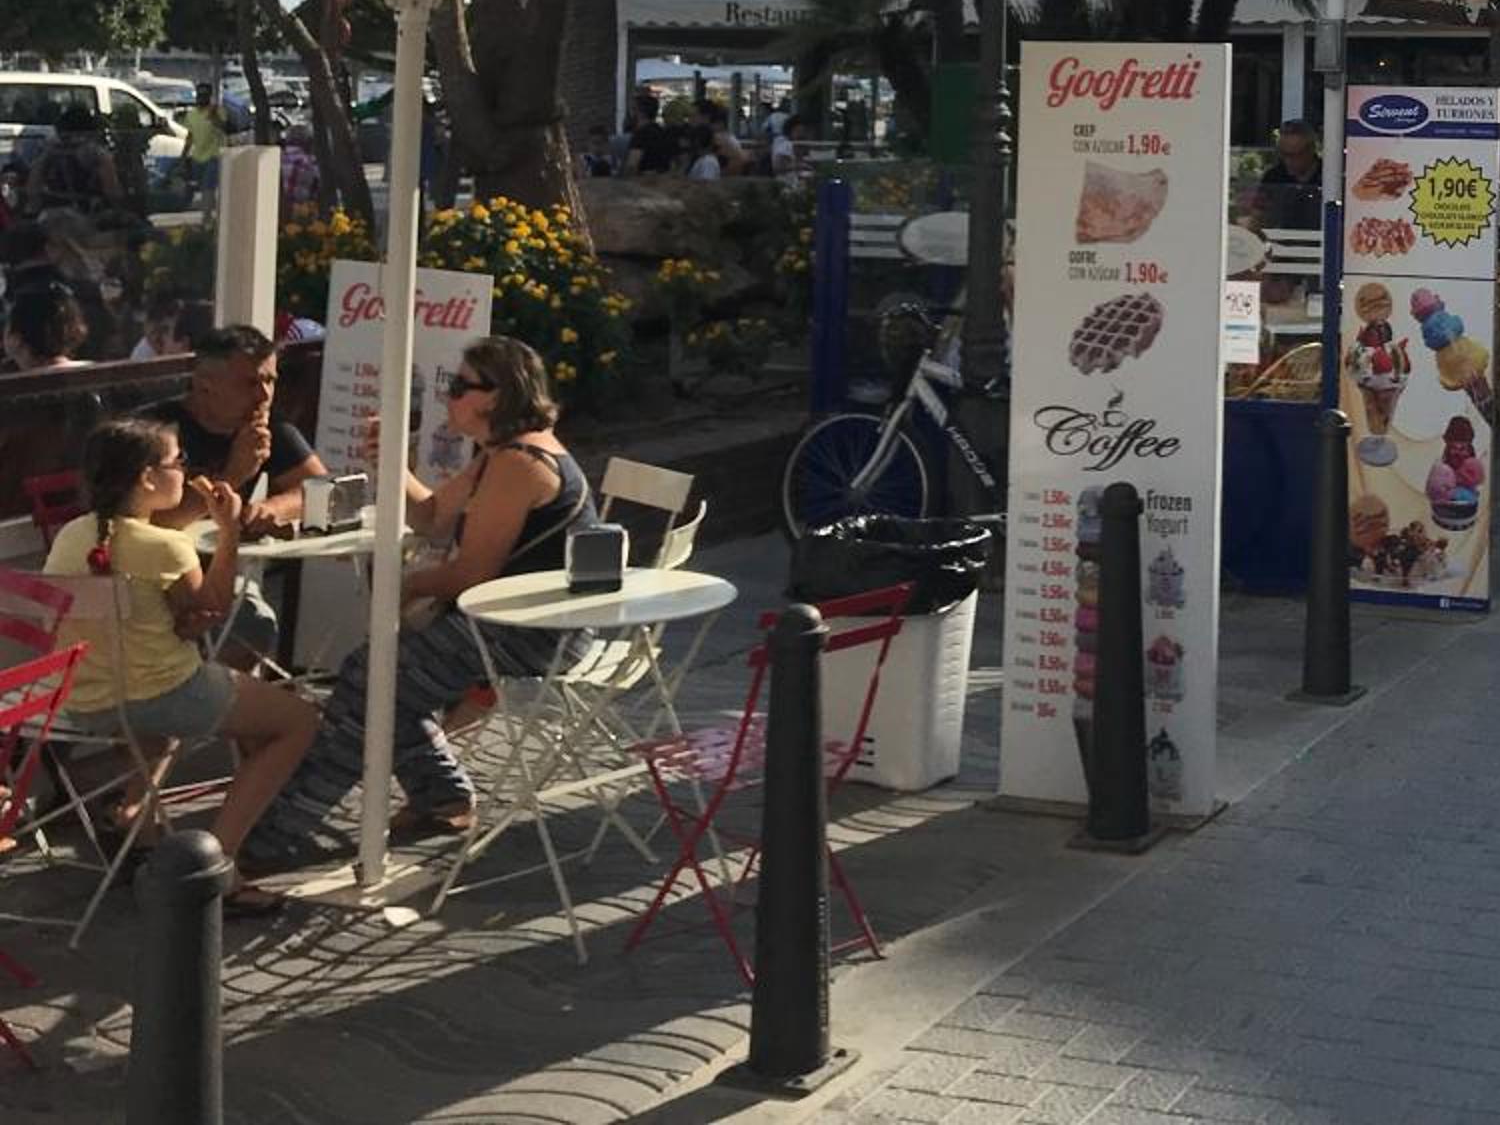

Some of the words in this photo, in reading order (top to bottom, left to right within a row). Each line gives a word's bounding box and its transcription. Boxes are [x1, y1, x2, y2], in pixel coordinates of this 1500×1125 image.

[1046, 53, 1201, 111] Goofretti
[1428, 178, 1477, 201] 1,90€
[1034, 406, 1181, 471] Coffee
[1146, 490, 1193, 512] Frozen
